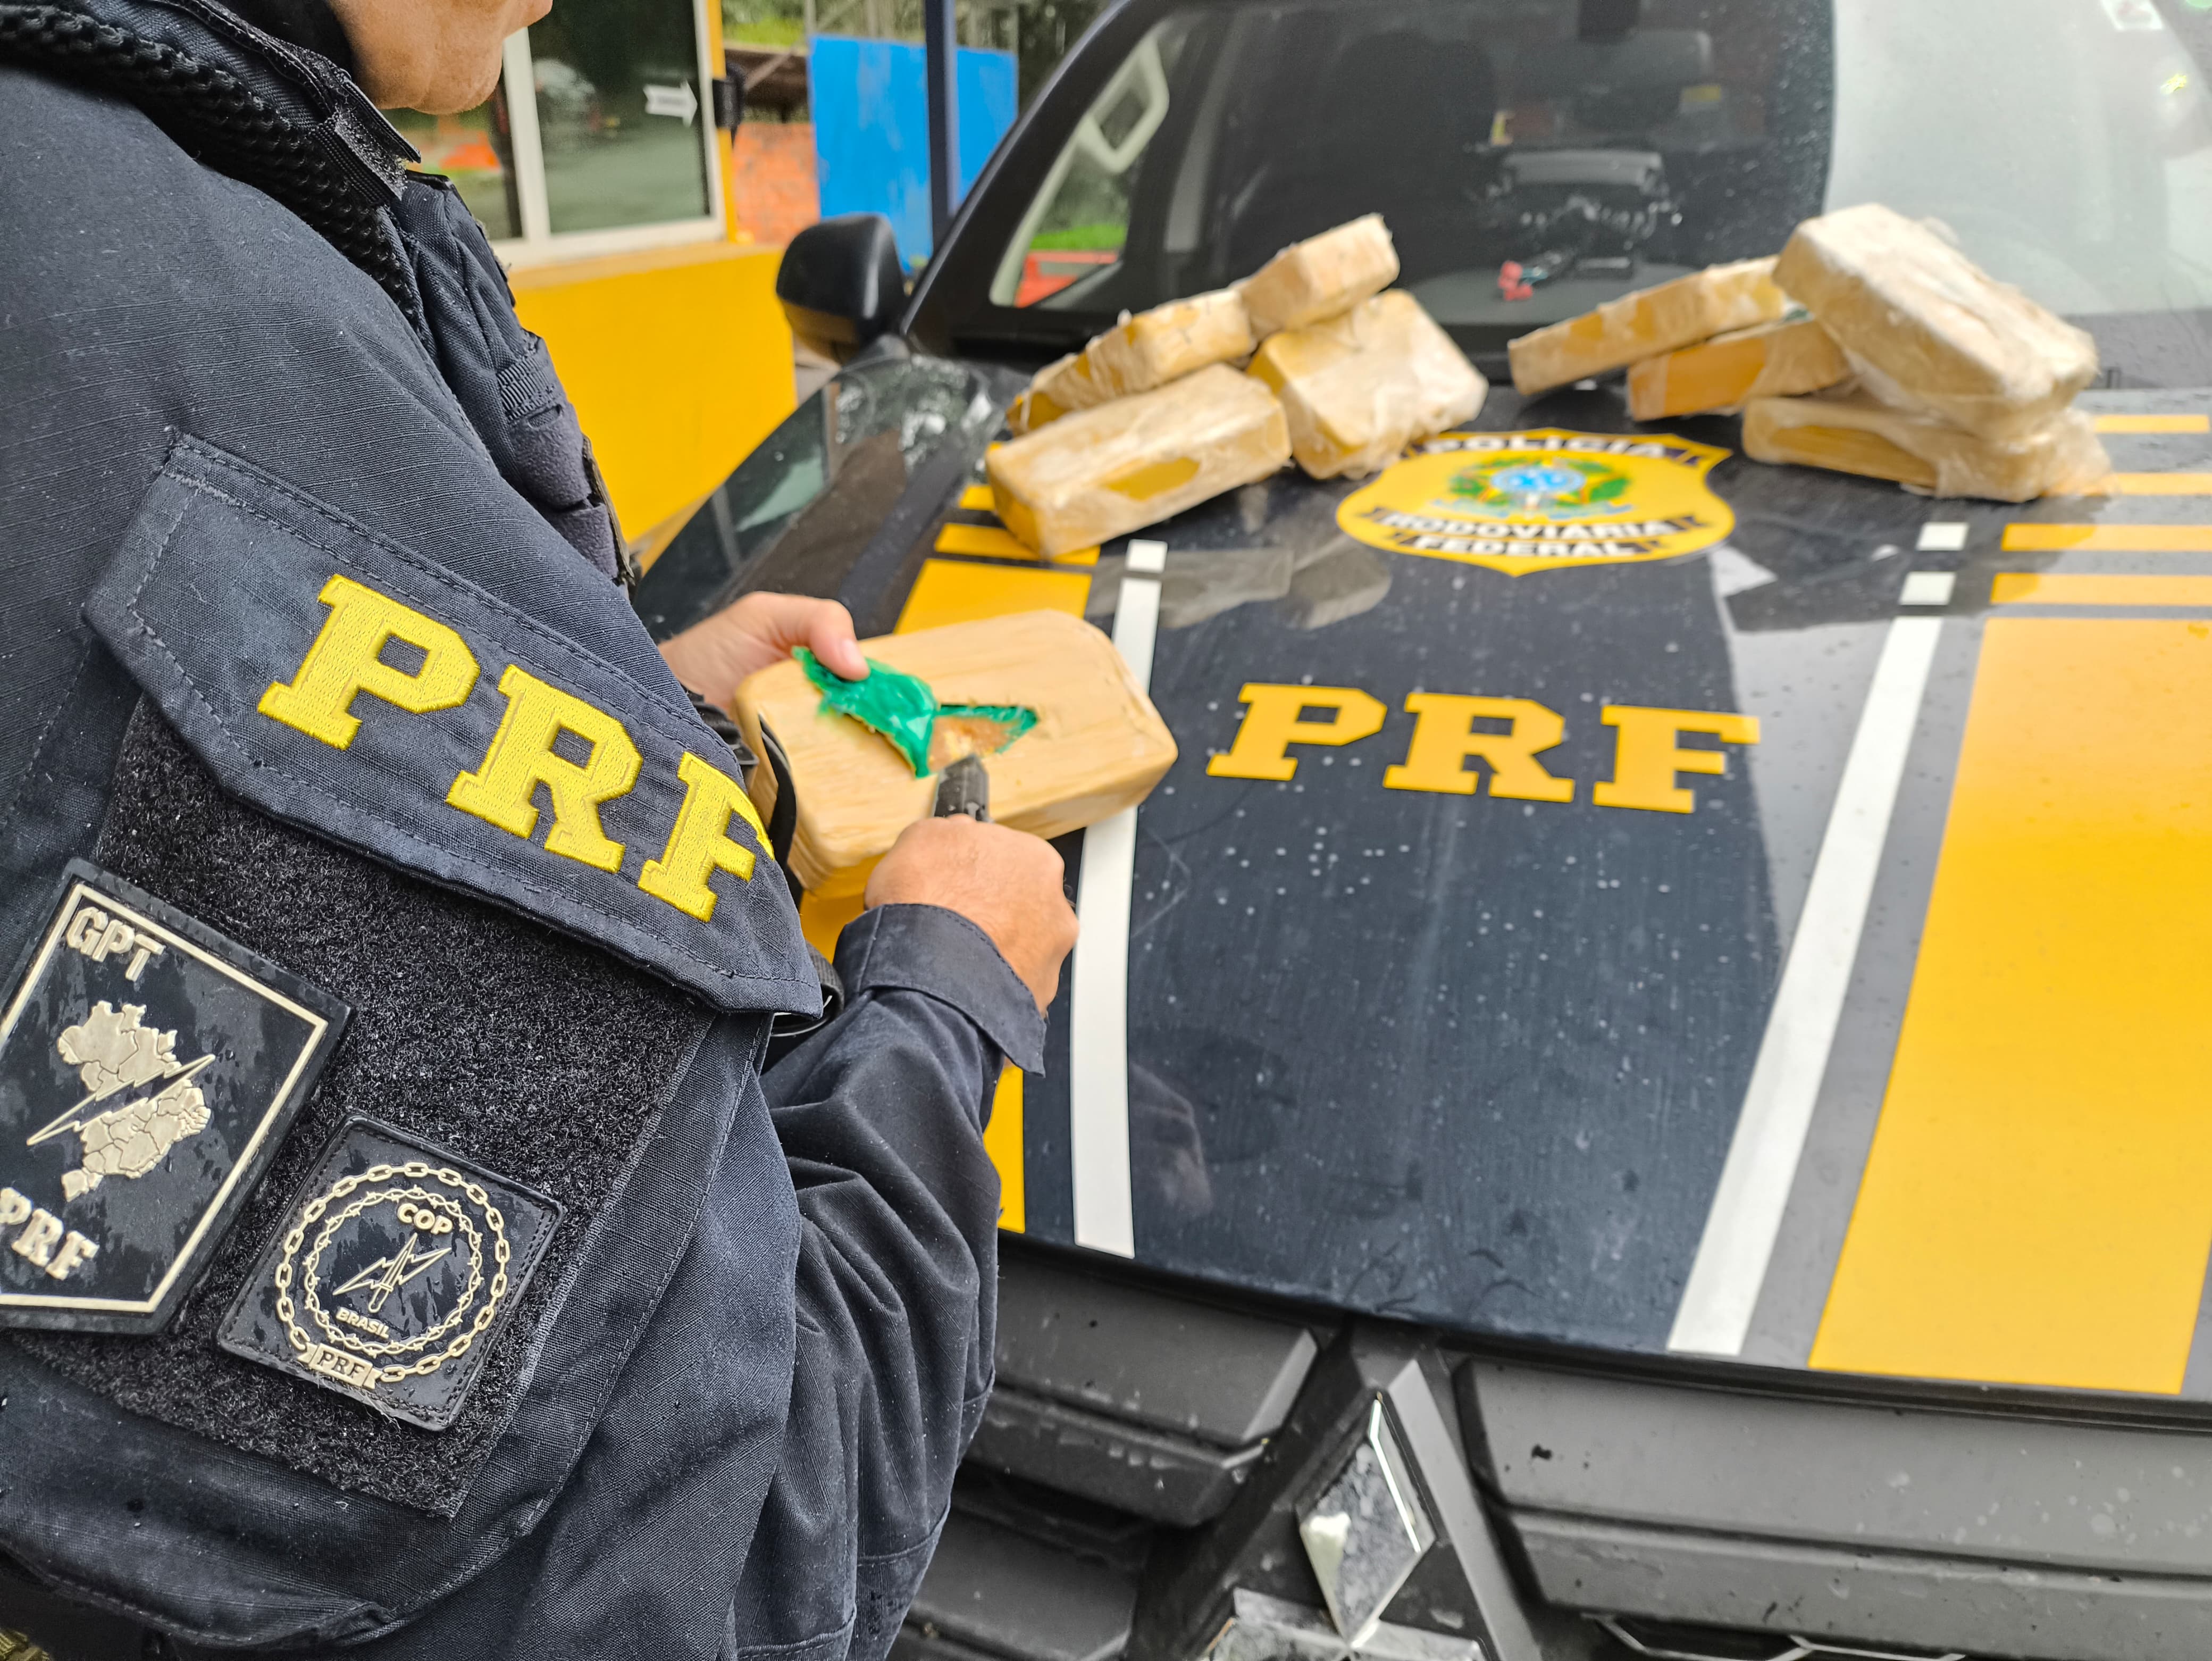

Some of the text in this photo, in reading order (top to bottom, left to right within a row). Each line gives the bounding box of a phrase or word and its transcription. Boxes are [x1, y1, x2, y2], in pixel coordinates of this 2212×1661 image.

[1412, 535, 1635, 556] FEDERAL
[257, 574, 774, 922] PRF
[1206, 682, 1760, 813] PRF
[66, 906, 165, 982] GPT
[397, 1203, 454, 1235] COP
[335, 1306, 390, 1339] BRASIL
[319, 1348, 365, 1378] PRF
